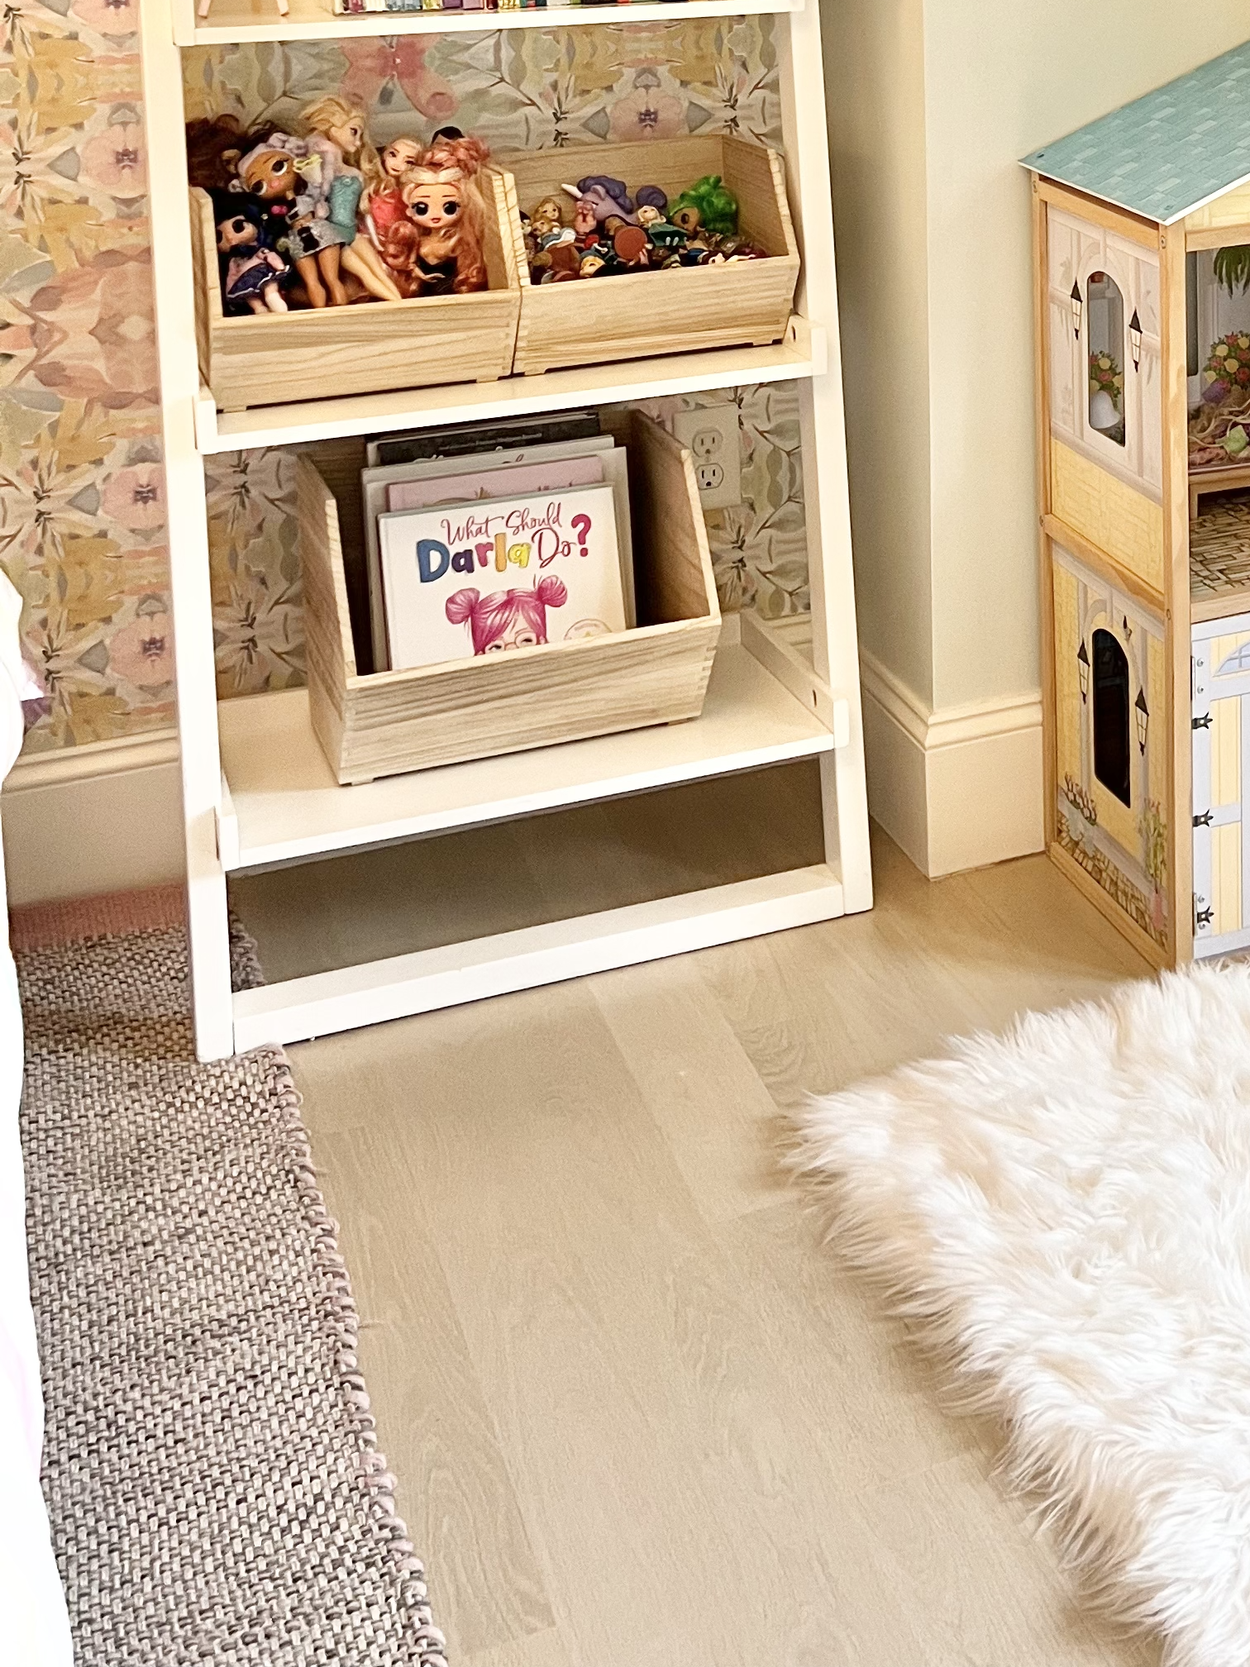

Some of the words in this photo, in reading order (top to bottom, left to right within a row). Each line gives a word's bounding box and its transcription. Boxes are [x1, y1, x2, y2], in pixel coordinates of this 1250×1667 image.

[416, 532, 532, 583] Darla
[531, 513, 592, 569] Do?
[440, 516, 505, 546] What
[506, 502, 563, 540] Should
